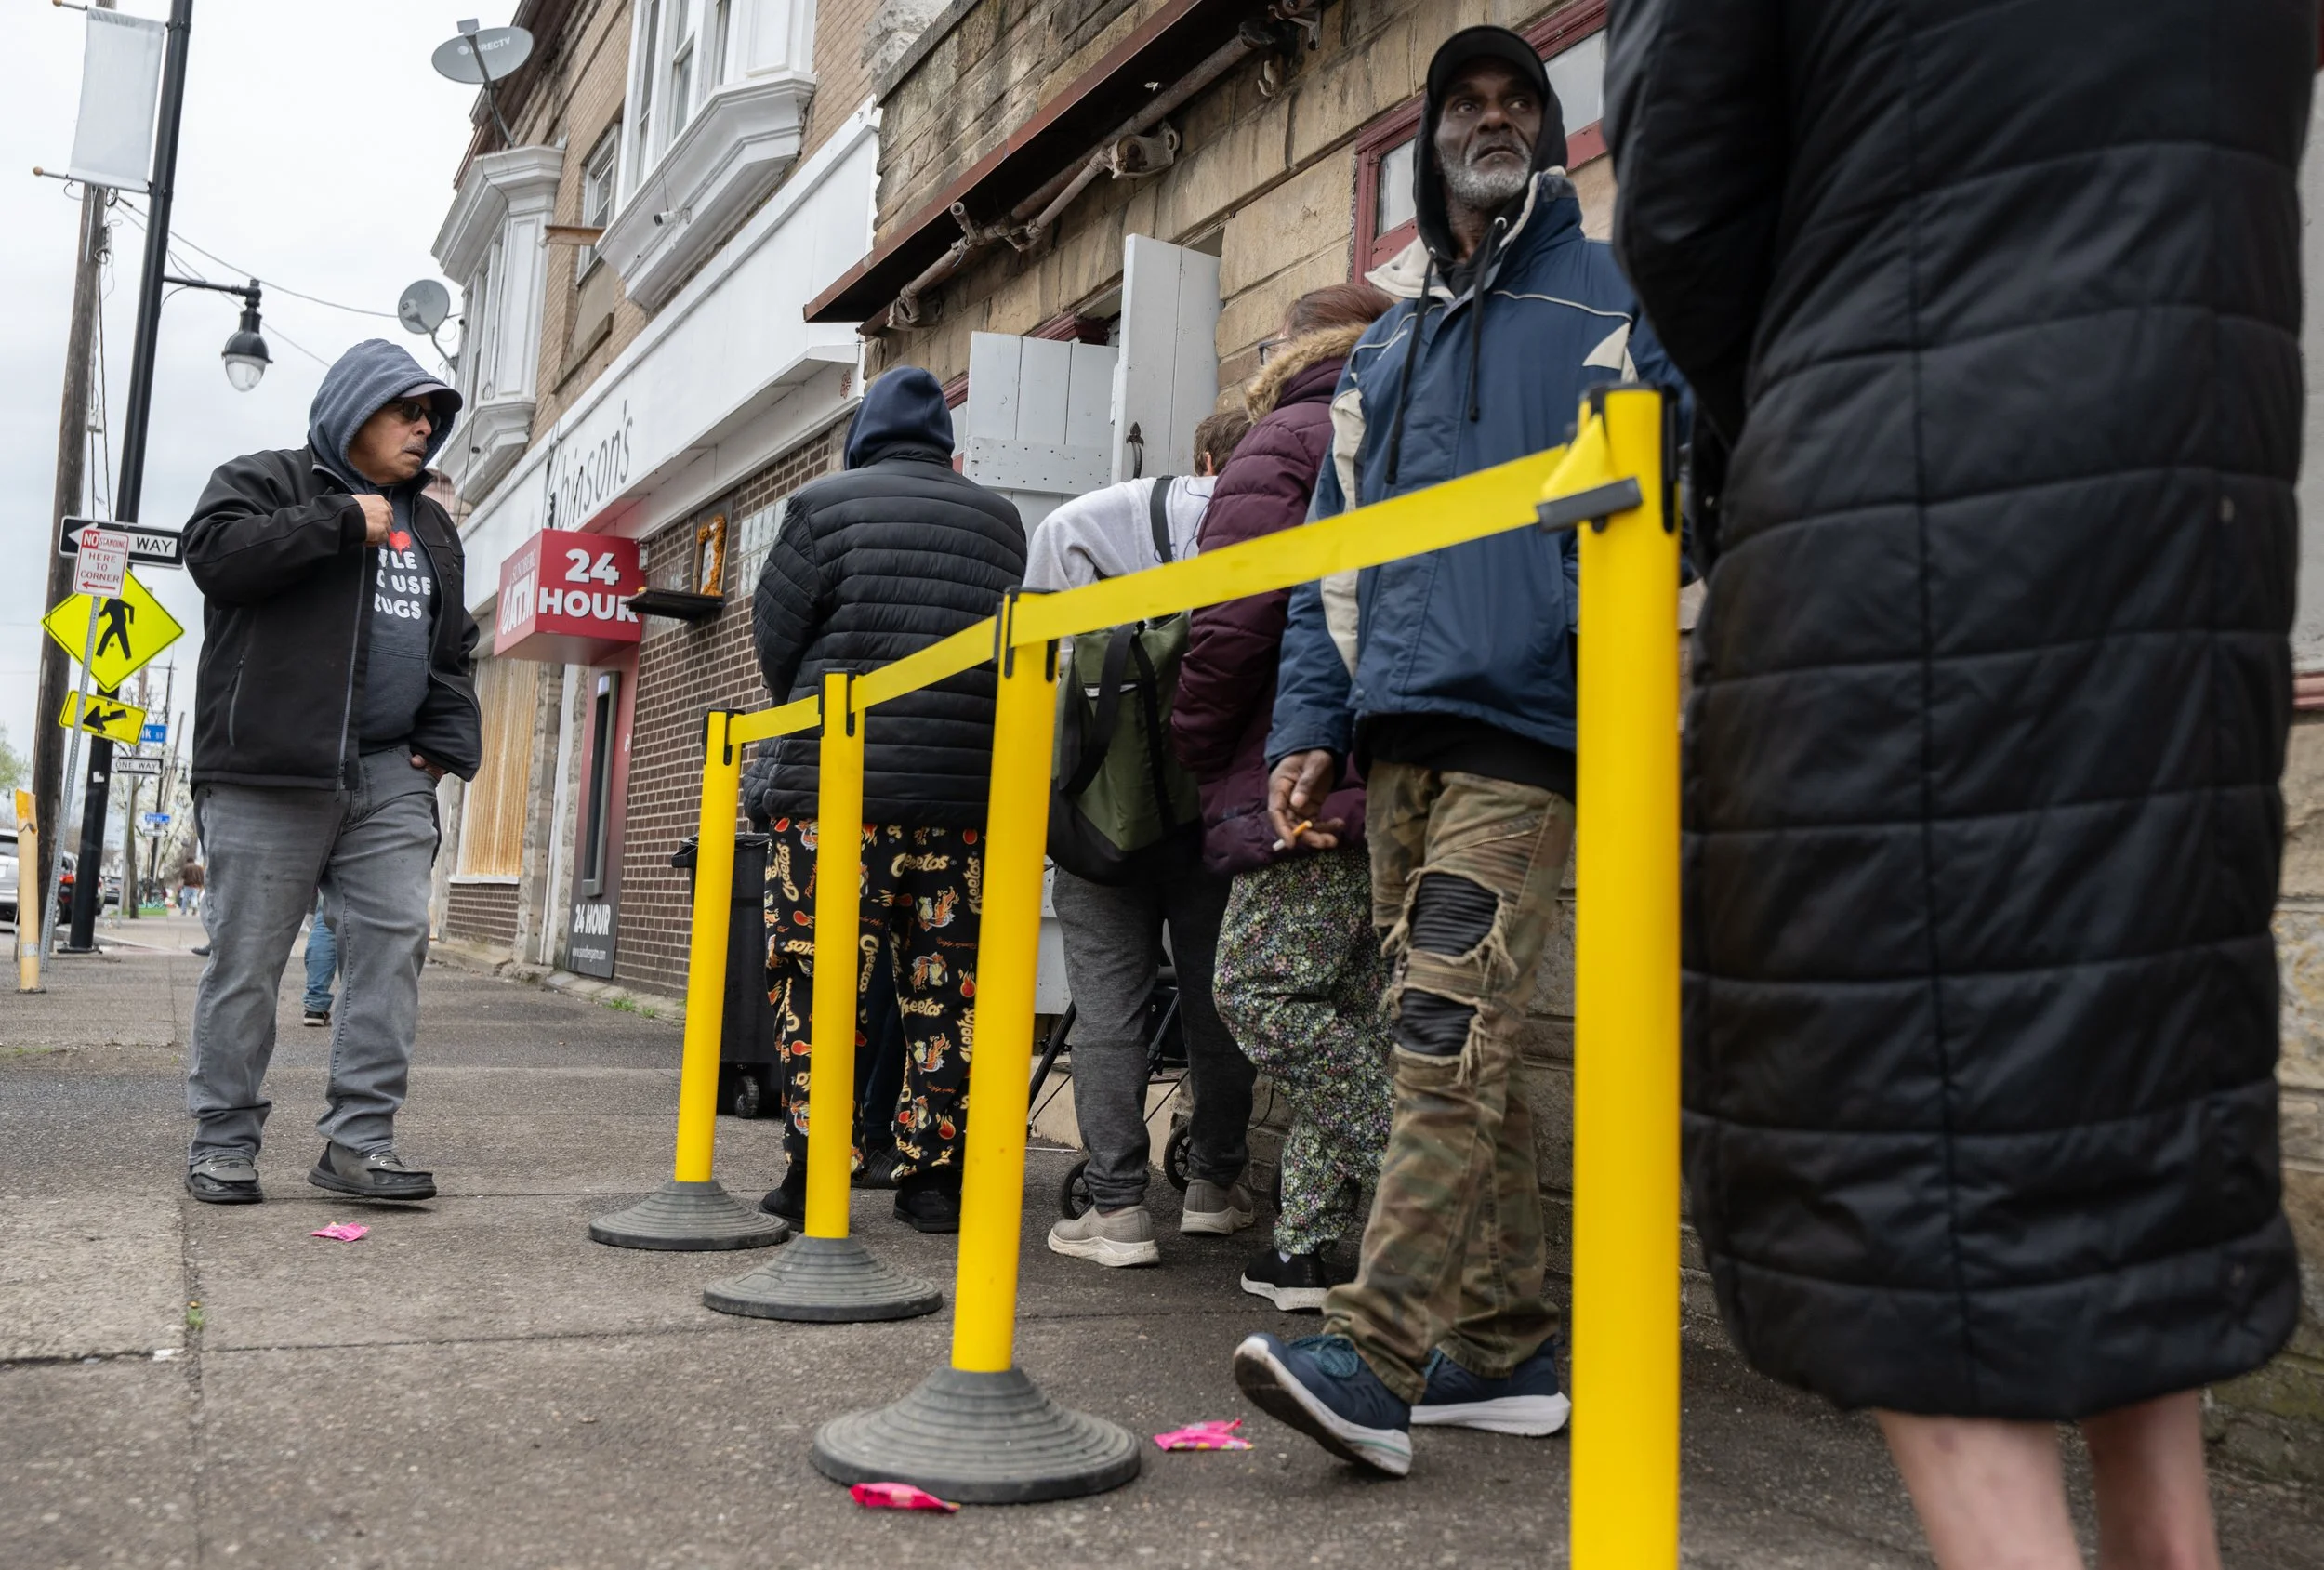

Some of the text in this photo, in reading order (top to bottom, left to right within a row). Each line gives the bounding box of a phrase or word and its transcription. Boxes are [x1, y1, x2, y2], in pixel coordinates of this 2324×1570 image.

[83, 532, 126, 549] NO STANDING
[136, 536, 173, 554] WAY
[88, 552, 117, 564] HERE
[96, 562, 108, 573] TO
[564, 548, 620, 586] 24
[80, 570, 120, 584] CORNER
[390, 574, 431, 596] USE
[538, 587, 639, 623] HOUR
[115, 760, 158, 771] ONE WAY
[776, 840, 799, 903] Cheetos
[574, 904, 611, 935] 24 HOUR
[897, 996, 944, 1017] heetos
